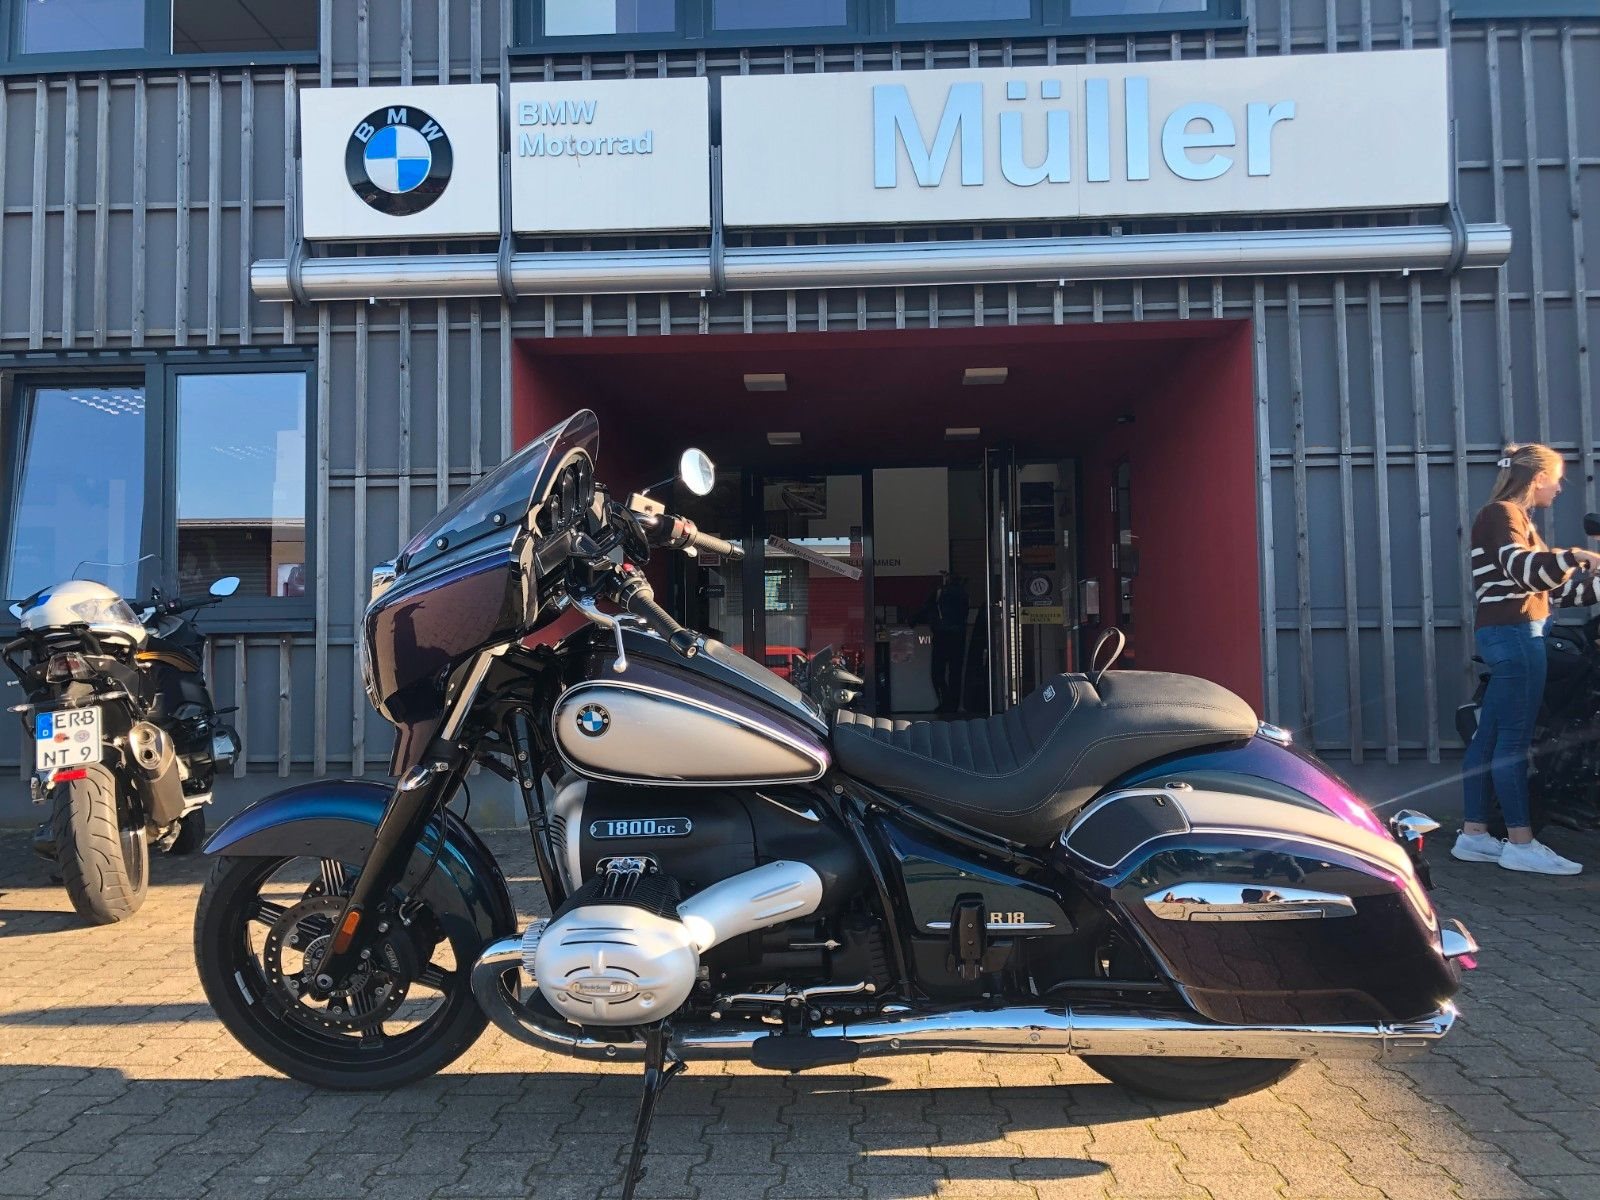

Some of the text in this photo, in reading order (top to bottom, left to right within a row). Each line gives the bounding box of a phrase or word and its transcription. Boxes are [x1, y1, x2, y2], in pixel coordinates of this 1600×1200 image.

[353, 107, 445, 145] BMW
[518, 99, 598, 127] BMW
[518, 130, 654, 158] Motorrad
[872, 75, 1295, 190] Müller
[44, 746, 92, 766] NT 9
[607, 820, 676, 836] 1800cc
